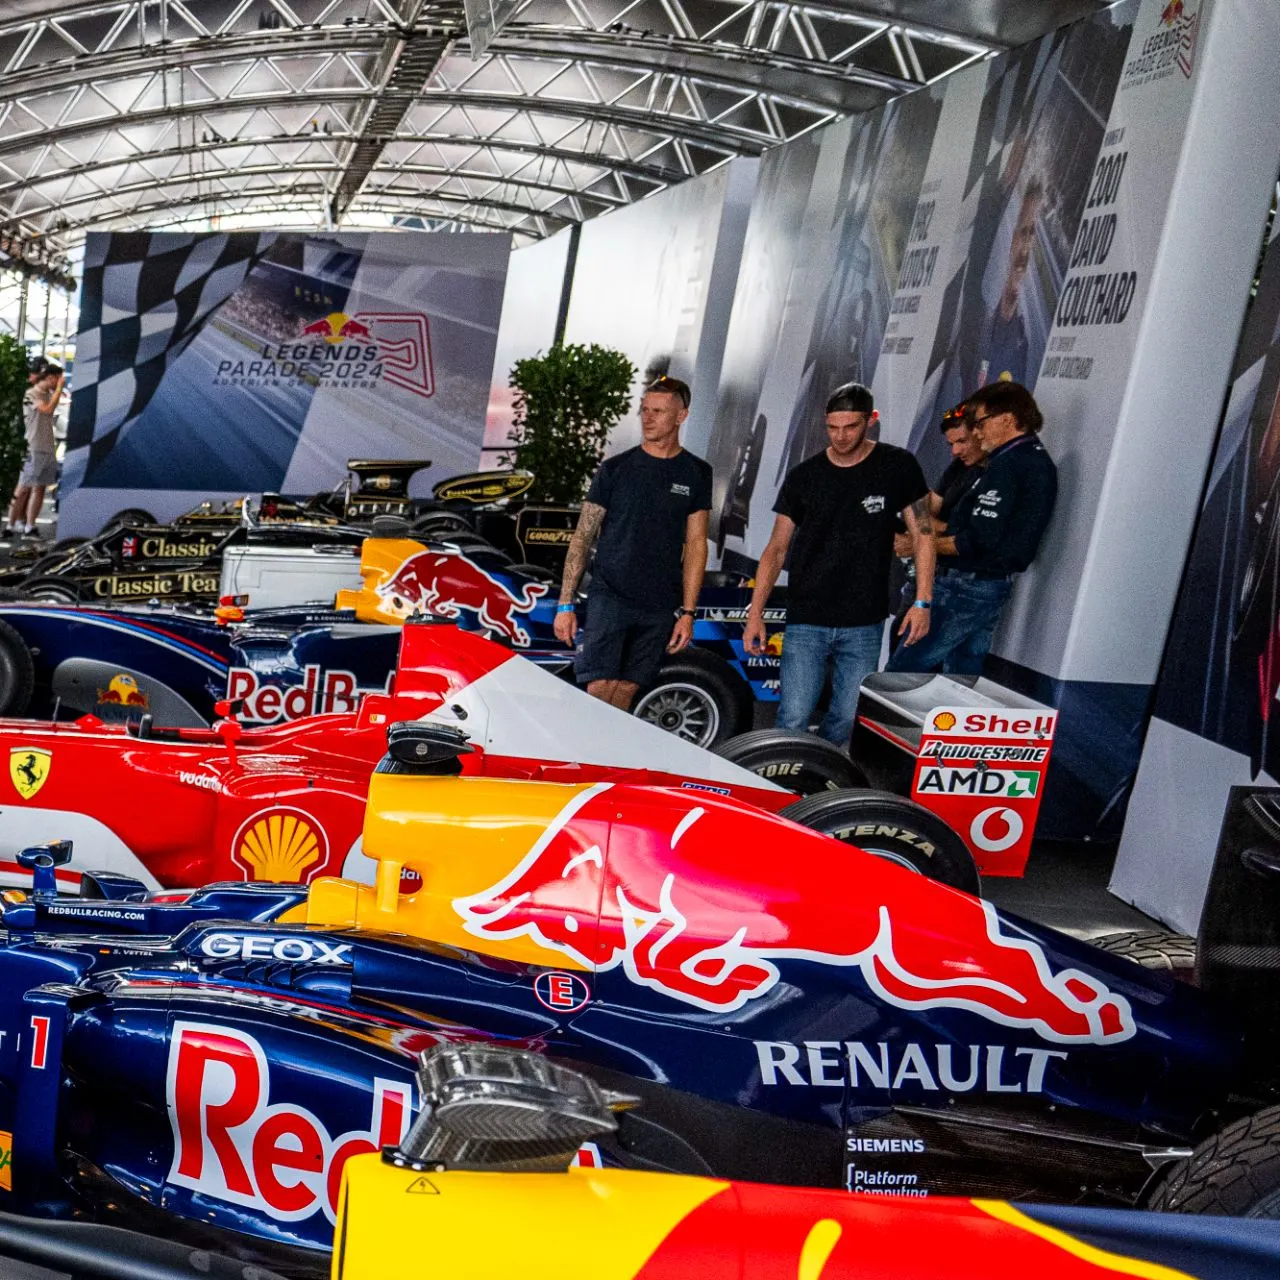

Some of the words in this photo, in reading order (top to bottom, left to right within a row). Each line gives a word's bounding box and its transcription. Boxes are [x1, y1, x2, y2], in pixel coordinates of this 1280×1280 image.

[1087, 152, 1128, 208] 2001
[1071, 213, 1118, 269] DAVID
[1056, 271, 1137, 328] COULTHARD
[262, 344, 379, 361] LEGENDS
[217, 360, 311, 378] PARADE
[319, 362, 385, 379] 2024
[143, 537, 217, 558] Classic
[528, 531, 572, 544] GOODYE
[95, 574, 172, 597] Classic
[177, 574, 217, 594] Tea
[226, 668, 321, 724] Red
[964, 714, 1054, 735] Shell
[920, 741, 1047, 762] BRIDGESTONE
[918, 769, 1006, 795] AMD
[830, 824, 936, 858] TENZA
[48, 906, 145, 921] REDBULLRACING.COM
[201, 933, 353, 965] GEOX
[30, 1015, 50, 1070] 1
[753, 1041, 1068, 1093] RENAULT
[846, 1138, 925, 1154] SIEMENS
[854, 1169, 918, 1188] Platform
